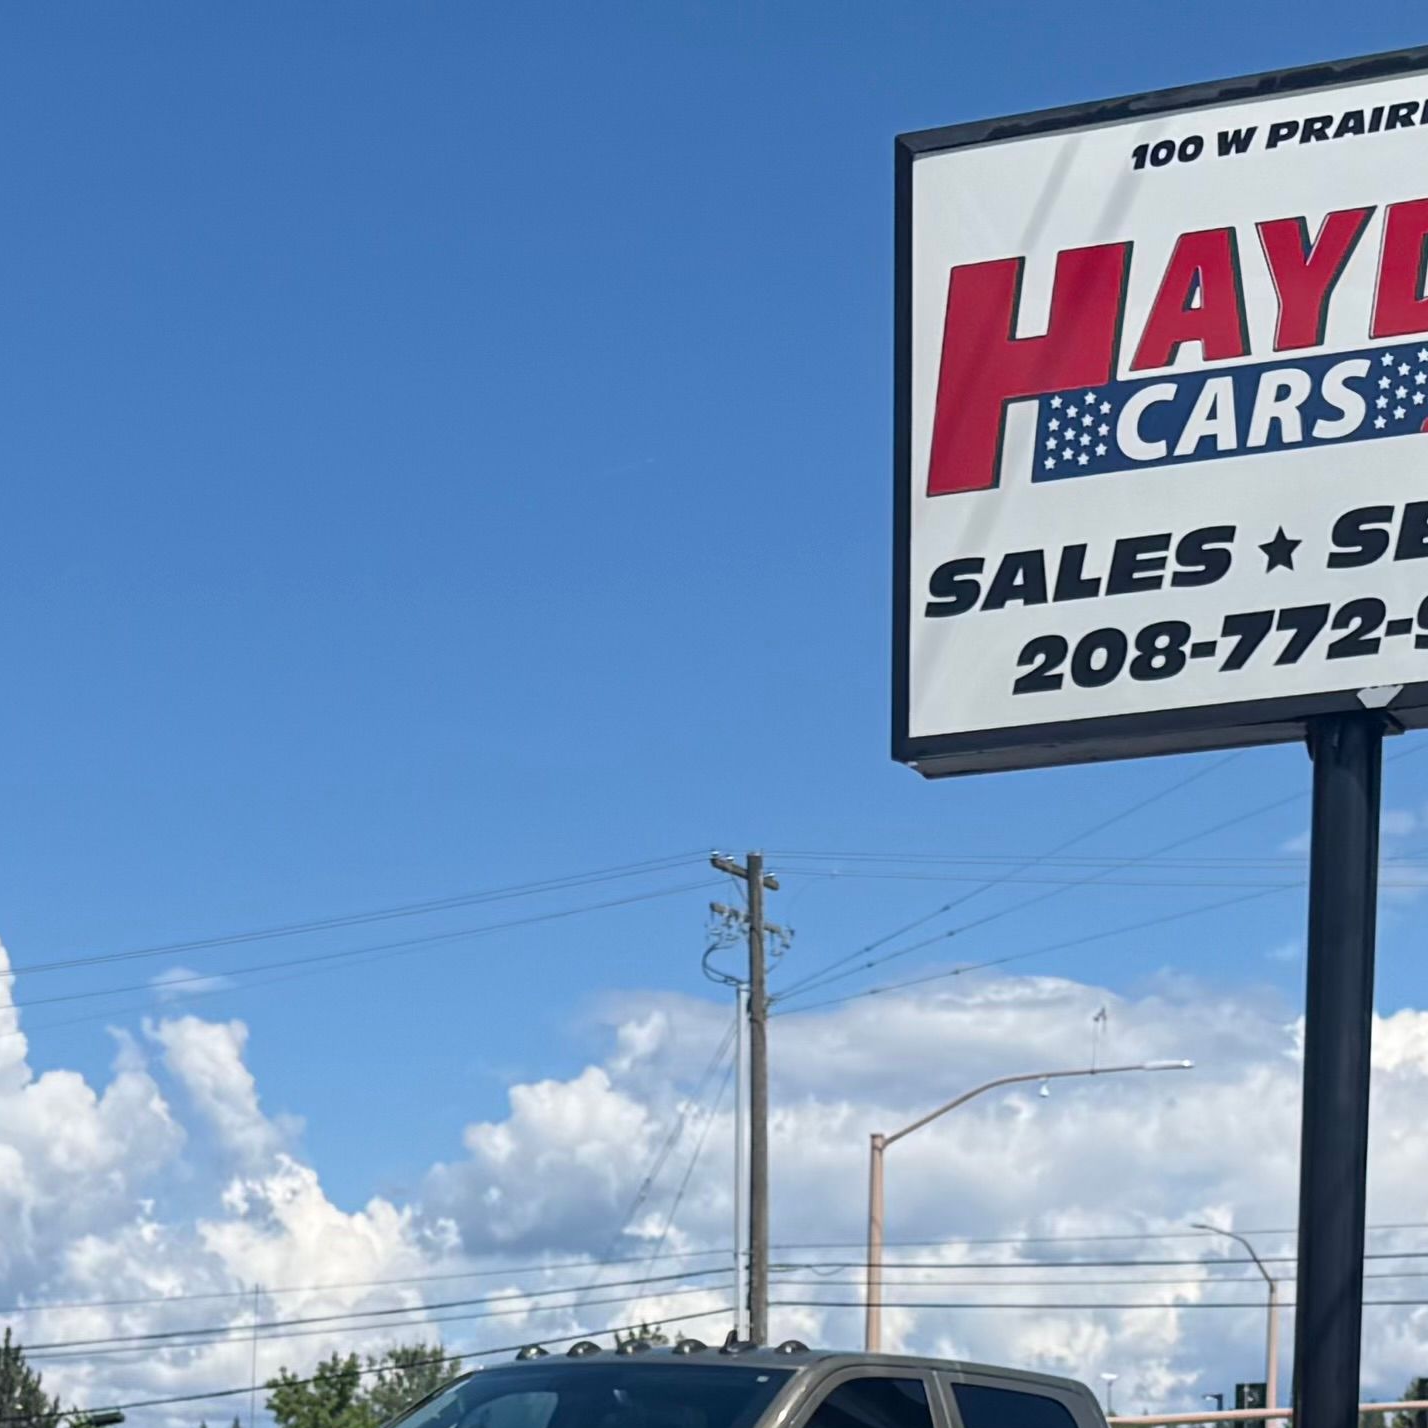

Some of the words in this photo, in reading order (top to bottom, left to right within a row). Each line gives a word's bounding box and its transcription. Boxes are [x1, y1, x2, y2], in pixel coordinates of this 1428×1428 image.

[1131, 133, 1204, 171] 100
[1215, 126, 1257, 157] W
[1115, 358, 1372, 462] CARS
[924, 525, 1239, 618] SALES
